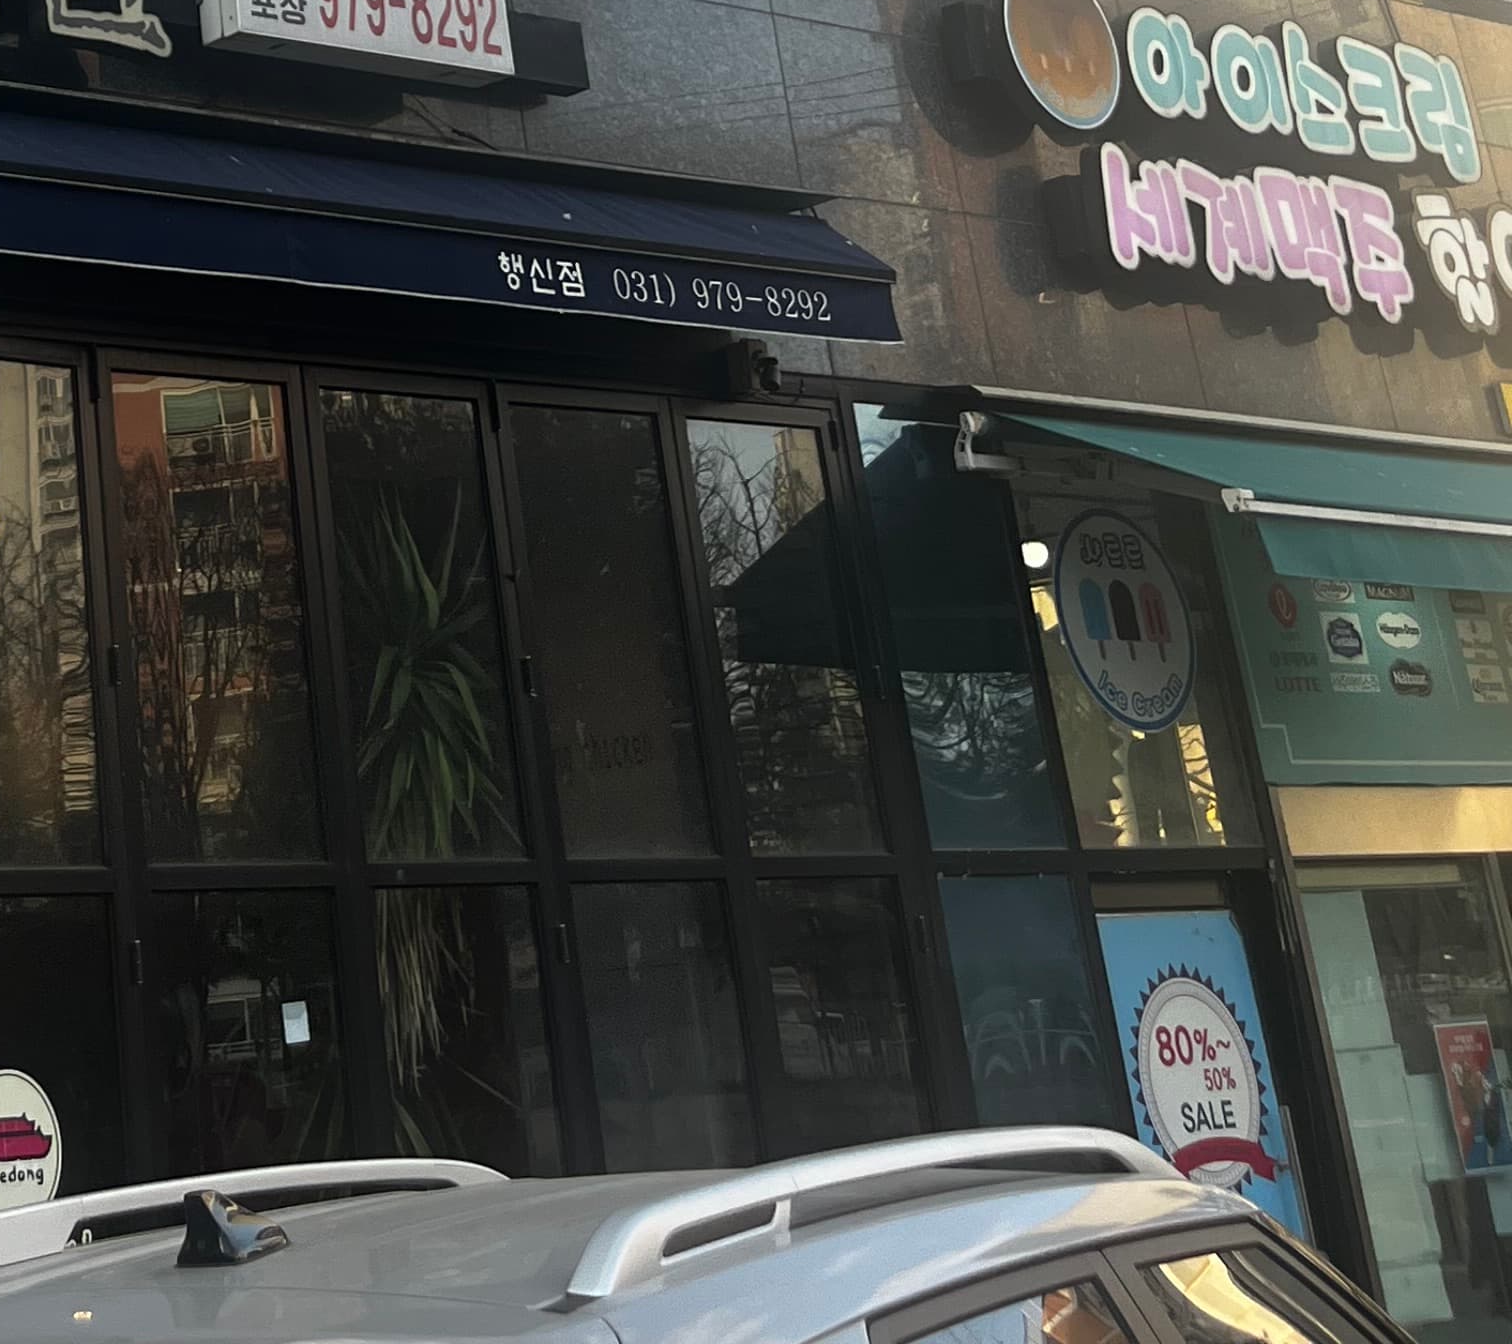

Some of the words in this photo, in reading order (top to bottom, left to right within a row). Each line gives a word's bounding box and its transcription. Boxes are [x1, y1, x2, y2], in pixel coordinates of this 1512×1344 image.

[1126, 6, 1483, 183] 아이스크림
[1100, 141, 1414, 324] 세계맥주
[497, 250, 586, 299] 행신점
[612, 268, 677, 307] 031)
[691, 277, 832, 322] 979-8292
[1203, 1066, 1237, 1092] 50%
[1180, 1099, 1238, 1134] SALE
